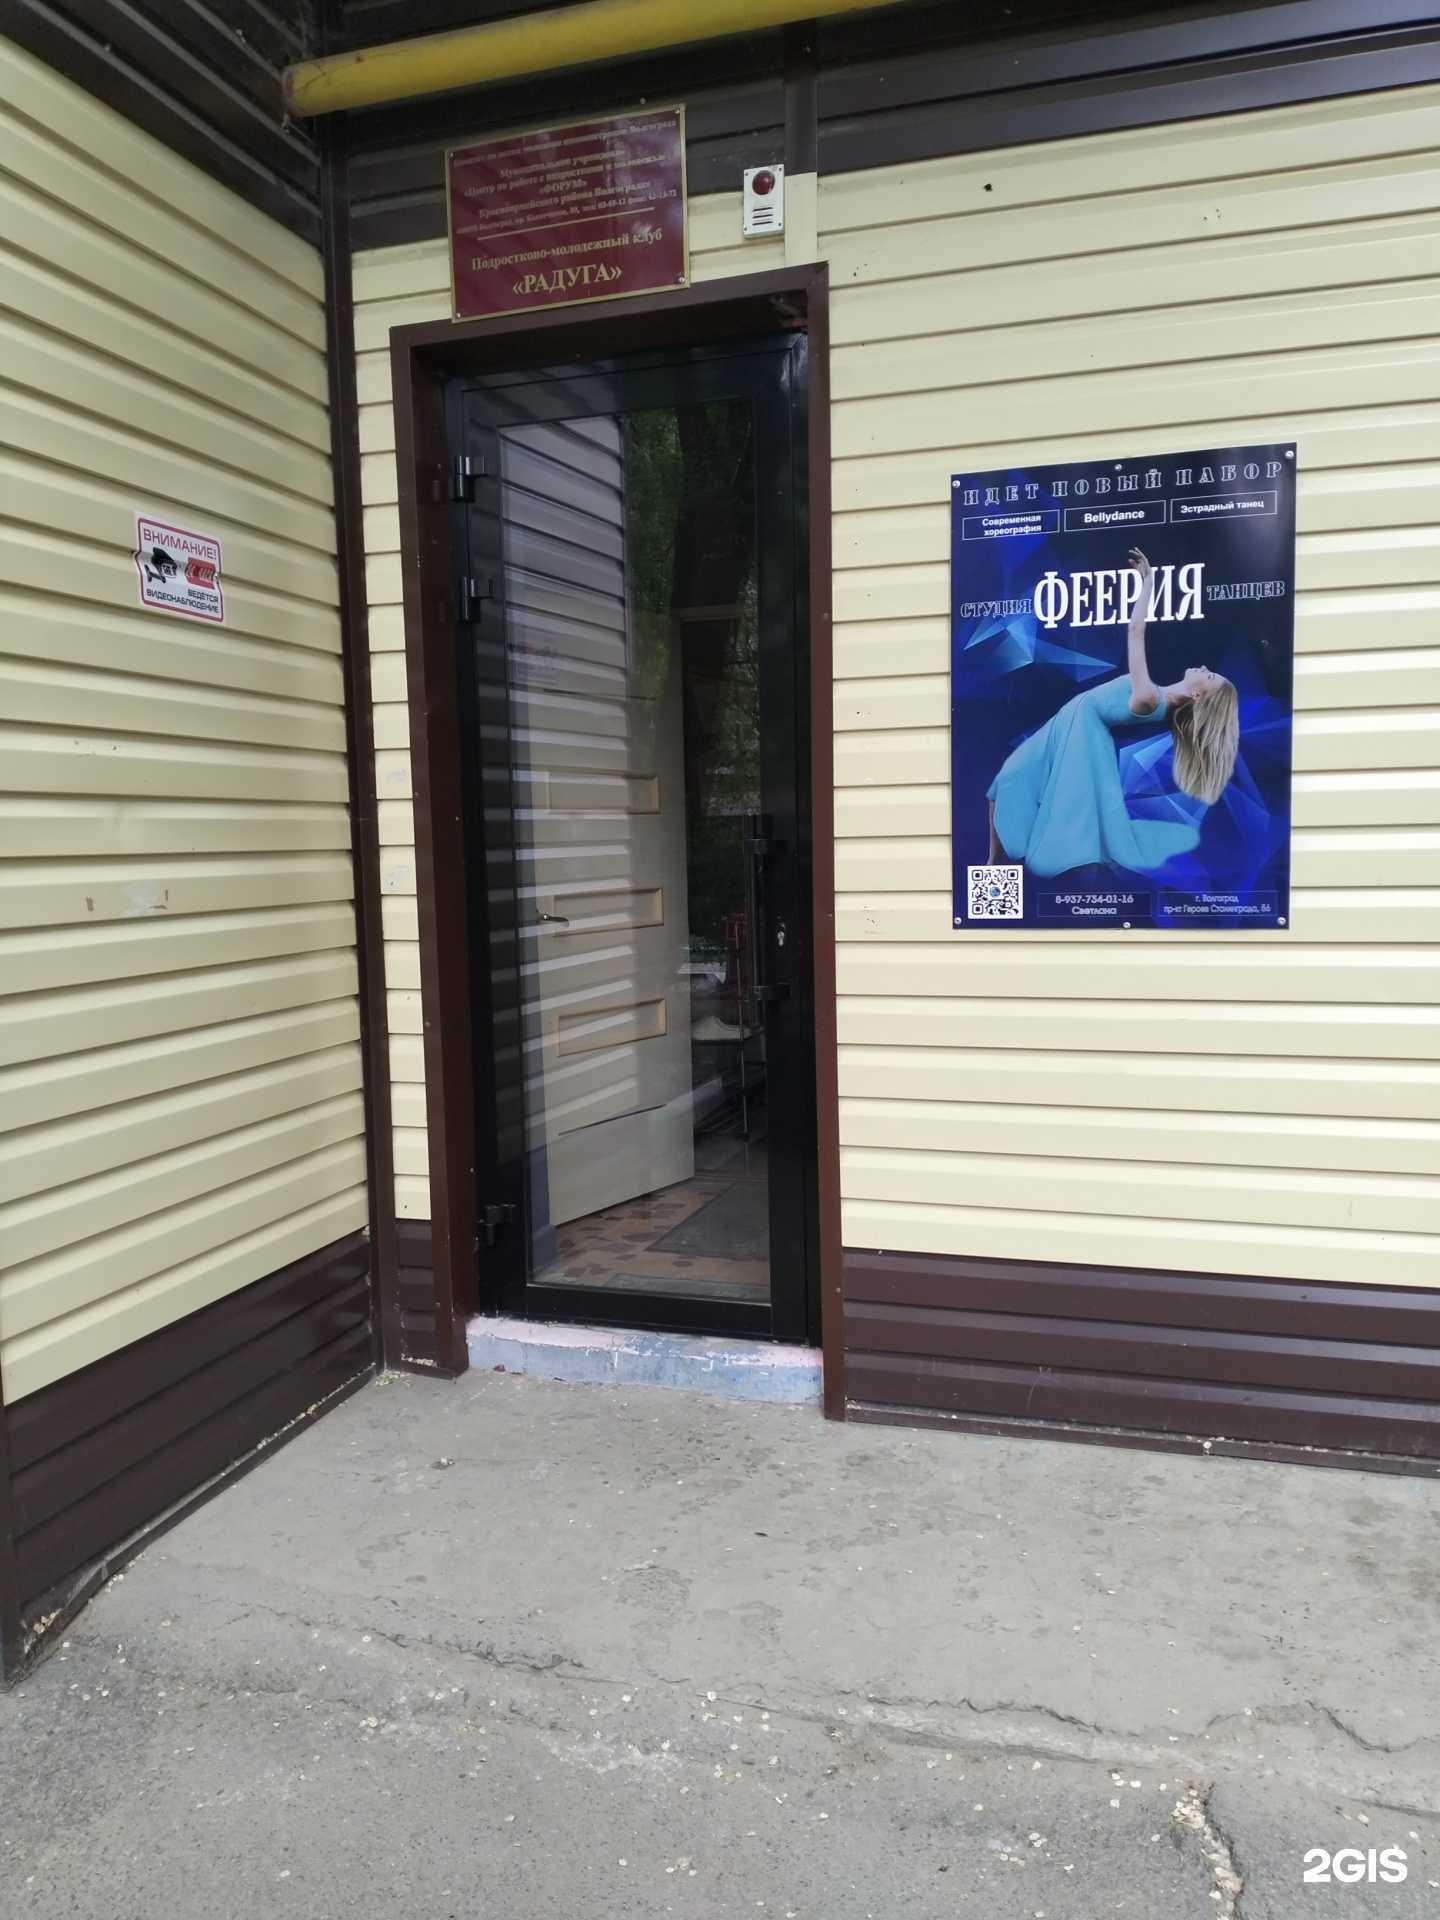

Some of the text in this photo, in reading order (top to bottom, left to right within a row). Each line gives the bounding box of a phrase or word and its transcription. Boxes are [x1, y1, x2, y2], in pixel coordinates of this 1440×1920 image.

[539, 179, 587, 195] «ФОРУМ»
[472, 227, 663, 271] Подростково-молодежный клуб
[512, 263, 623, 295] «РАДУГА»
[963, 461, 1282, 507] ИДЕТ НОВЫЙ НАБОР
[1084, 510, 1145, 524] Bellydance
[1180, 500, 1265, 514] Эстрадный танец
[982, 514, 1042, 527] Современная
[983, 524, 1042, 536] хореография
[143, 528, 217, 560] ВНИМАНИЕ!
[146, 588, 220, 613] ВИДЕОНАБЛЮДЕНИЕ
[960, 562, 1286, 629] СТУДИЯ ФЕЕРИЯ ТАНЦЕВ
